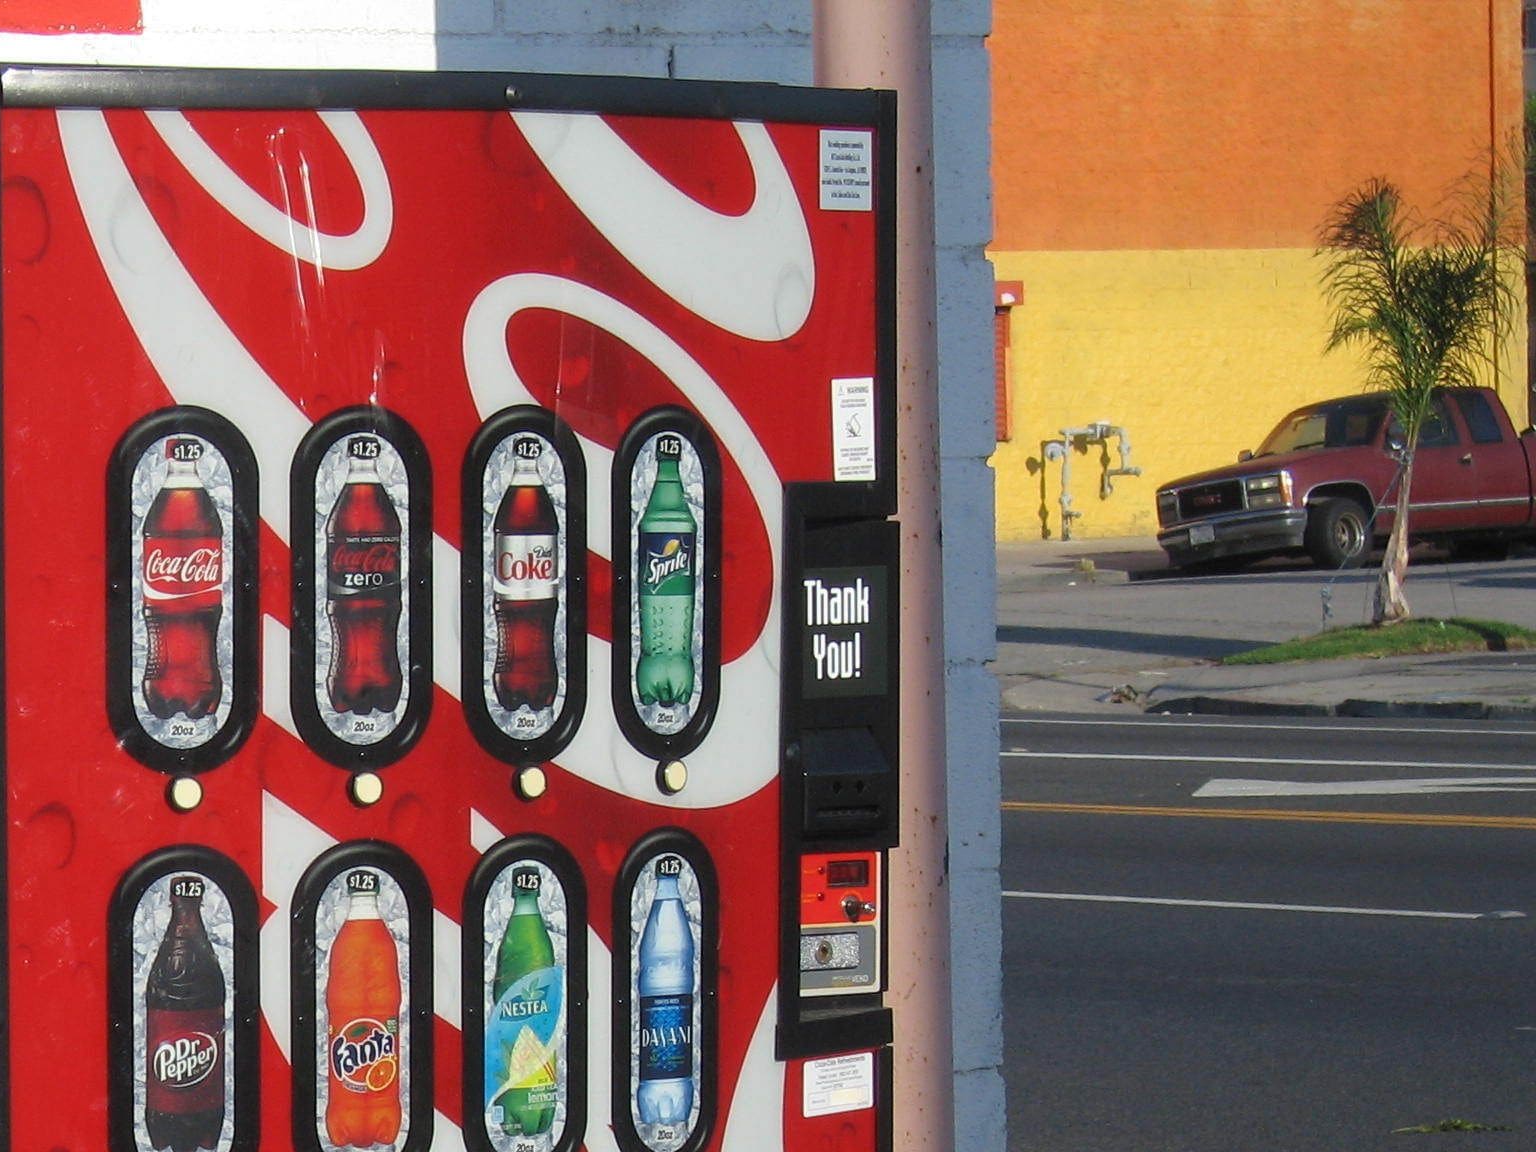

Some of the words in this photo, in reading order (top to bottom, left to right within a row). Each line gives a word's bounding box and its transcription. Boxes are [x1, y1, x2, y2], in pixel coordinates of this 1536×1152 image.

[173, 443, 201, 459] $1.25
[352, 441, 379, 456] $1.25
[517, 442, 541, 457] $1.25
[660, 440, 679, 454] $1.25
[145, 548, 221, 582] Coca-Cola
[498, 551, 553, 581] Coke
[647, 549, 688, 585] Sprite
[344, 572, 384, 587] zero
[803, 577, 869, 626] Thank
[813, 631, 862, 680] You!
[171, 724, 195, 737] 20oz
[353, 721, 375, 733] 20oz
[659, 859, 680, 875] $1.25
[175, 880, 202, 898] $1.25
[350, 873, 375, 890] $1.25
[517, 873, 540, 890] $1.25
[502, 998, 549, 1018] NESTEA
[642, 1024, 691, 1048] DASANI
[175, 1038, 200, 1061] Dr
[331, 1028, 395, 1081] Fanta
[155, 1043, 214, 1082] Pepper
